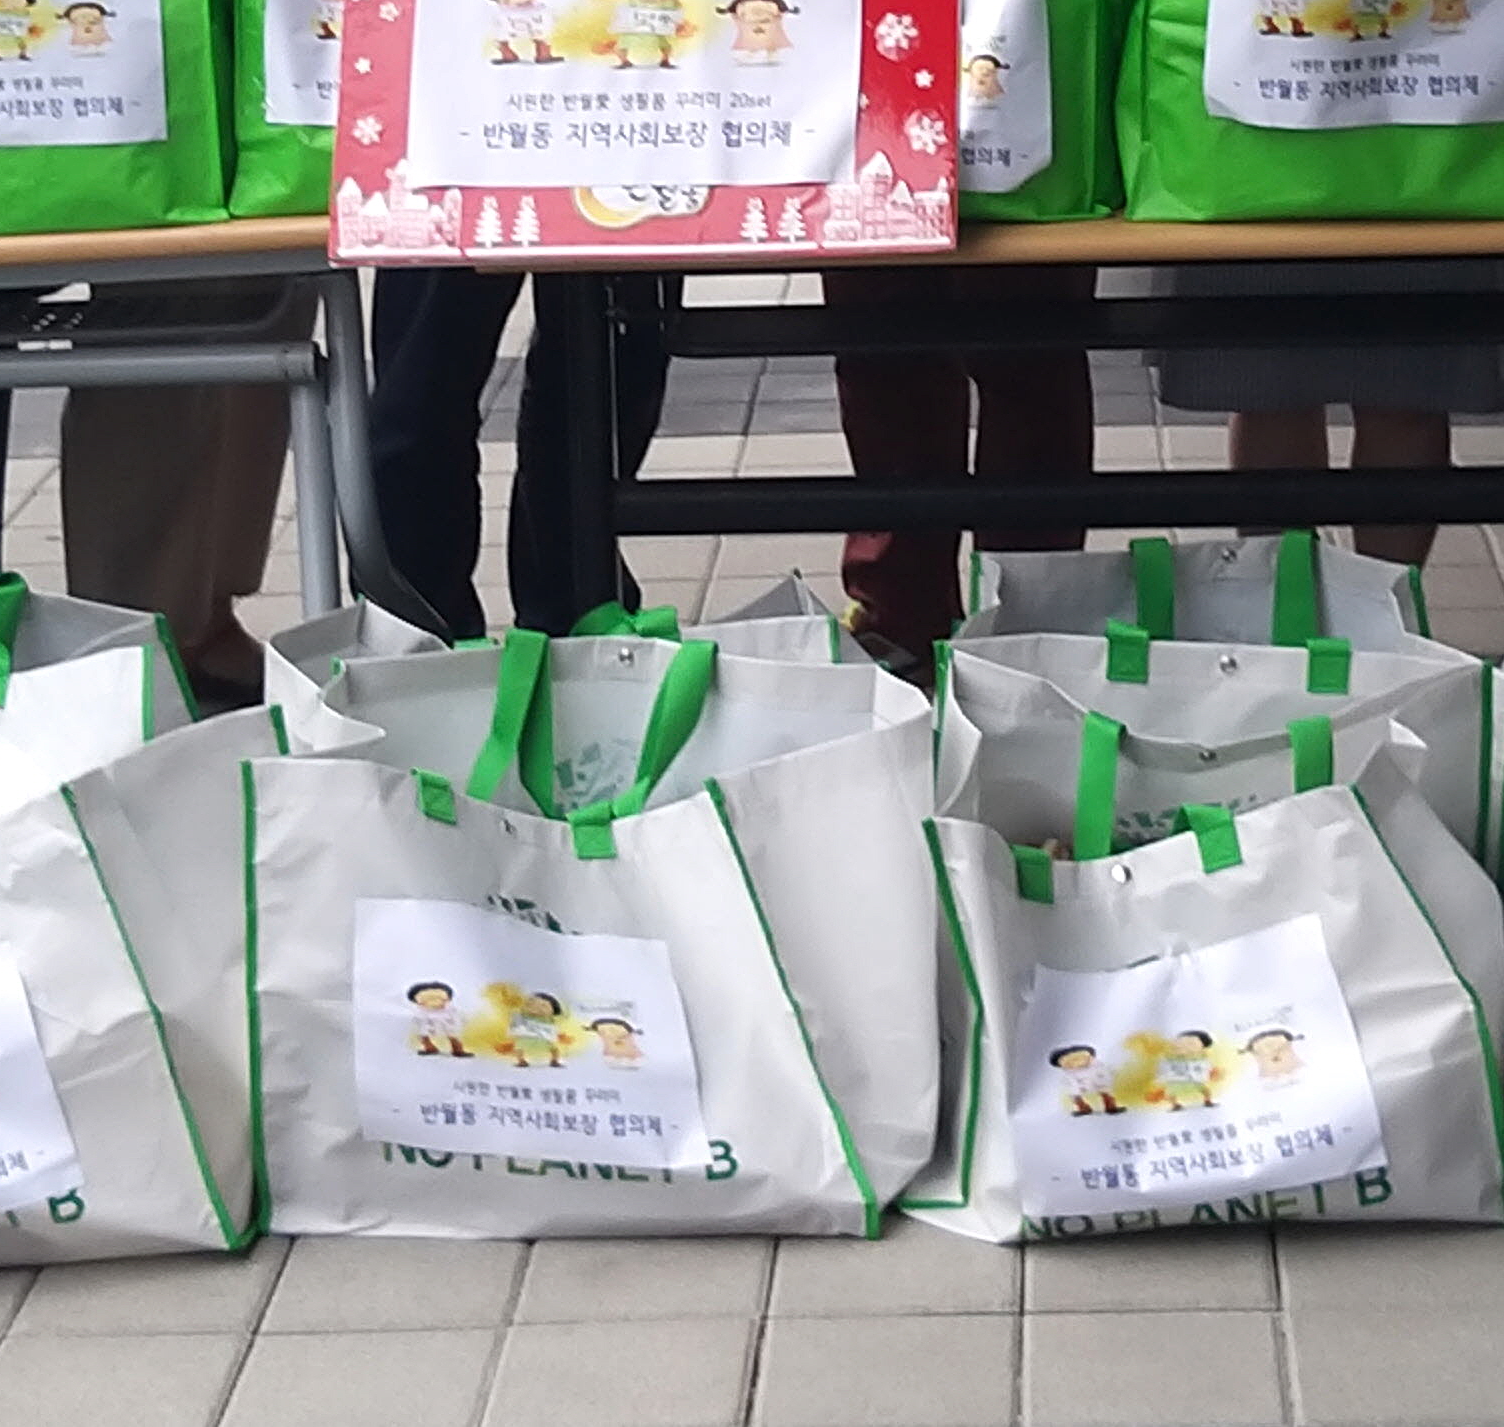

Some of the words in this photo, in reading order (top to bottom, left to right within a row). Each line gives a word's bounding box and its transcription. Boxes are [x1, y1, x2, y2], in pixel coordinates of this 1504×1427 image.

[1258, 77, 1311, 102] 반월동
[1319, 77, 1418, 100] 지역사회보장
[1428, 75, 1479, 97] 협의체
[73, 94, 124, 118] 협의체
[483, 122, 553, 150] 반월동
[566, 121, 708, 149] 지역사회보장
[720, 120, 792, 148] 협의체
[419, 1101, 476, 1126] 반월동
[488, 1103, 598, 1137] 지역사회보장
[609, 1109, 663, 1138] 협의체
[1080, 1163, 1139, 1192] 반월동
[1275, 1123, 1335, 1157] 협의체
[1354, 1166, 1394, 1207] B
